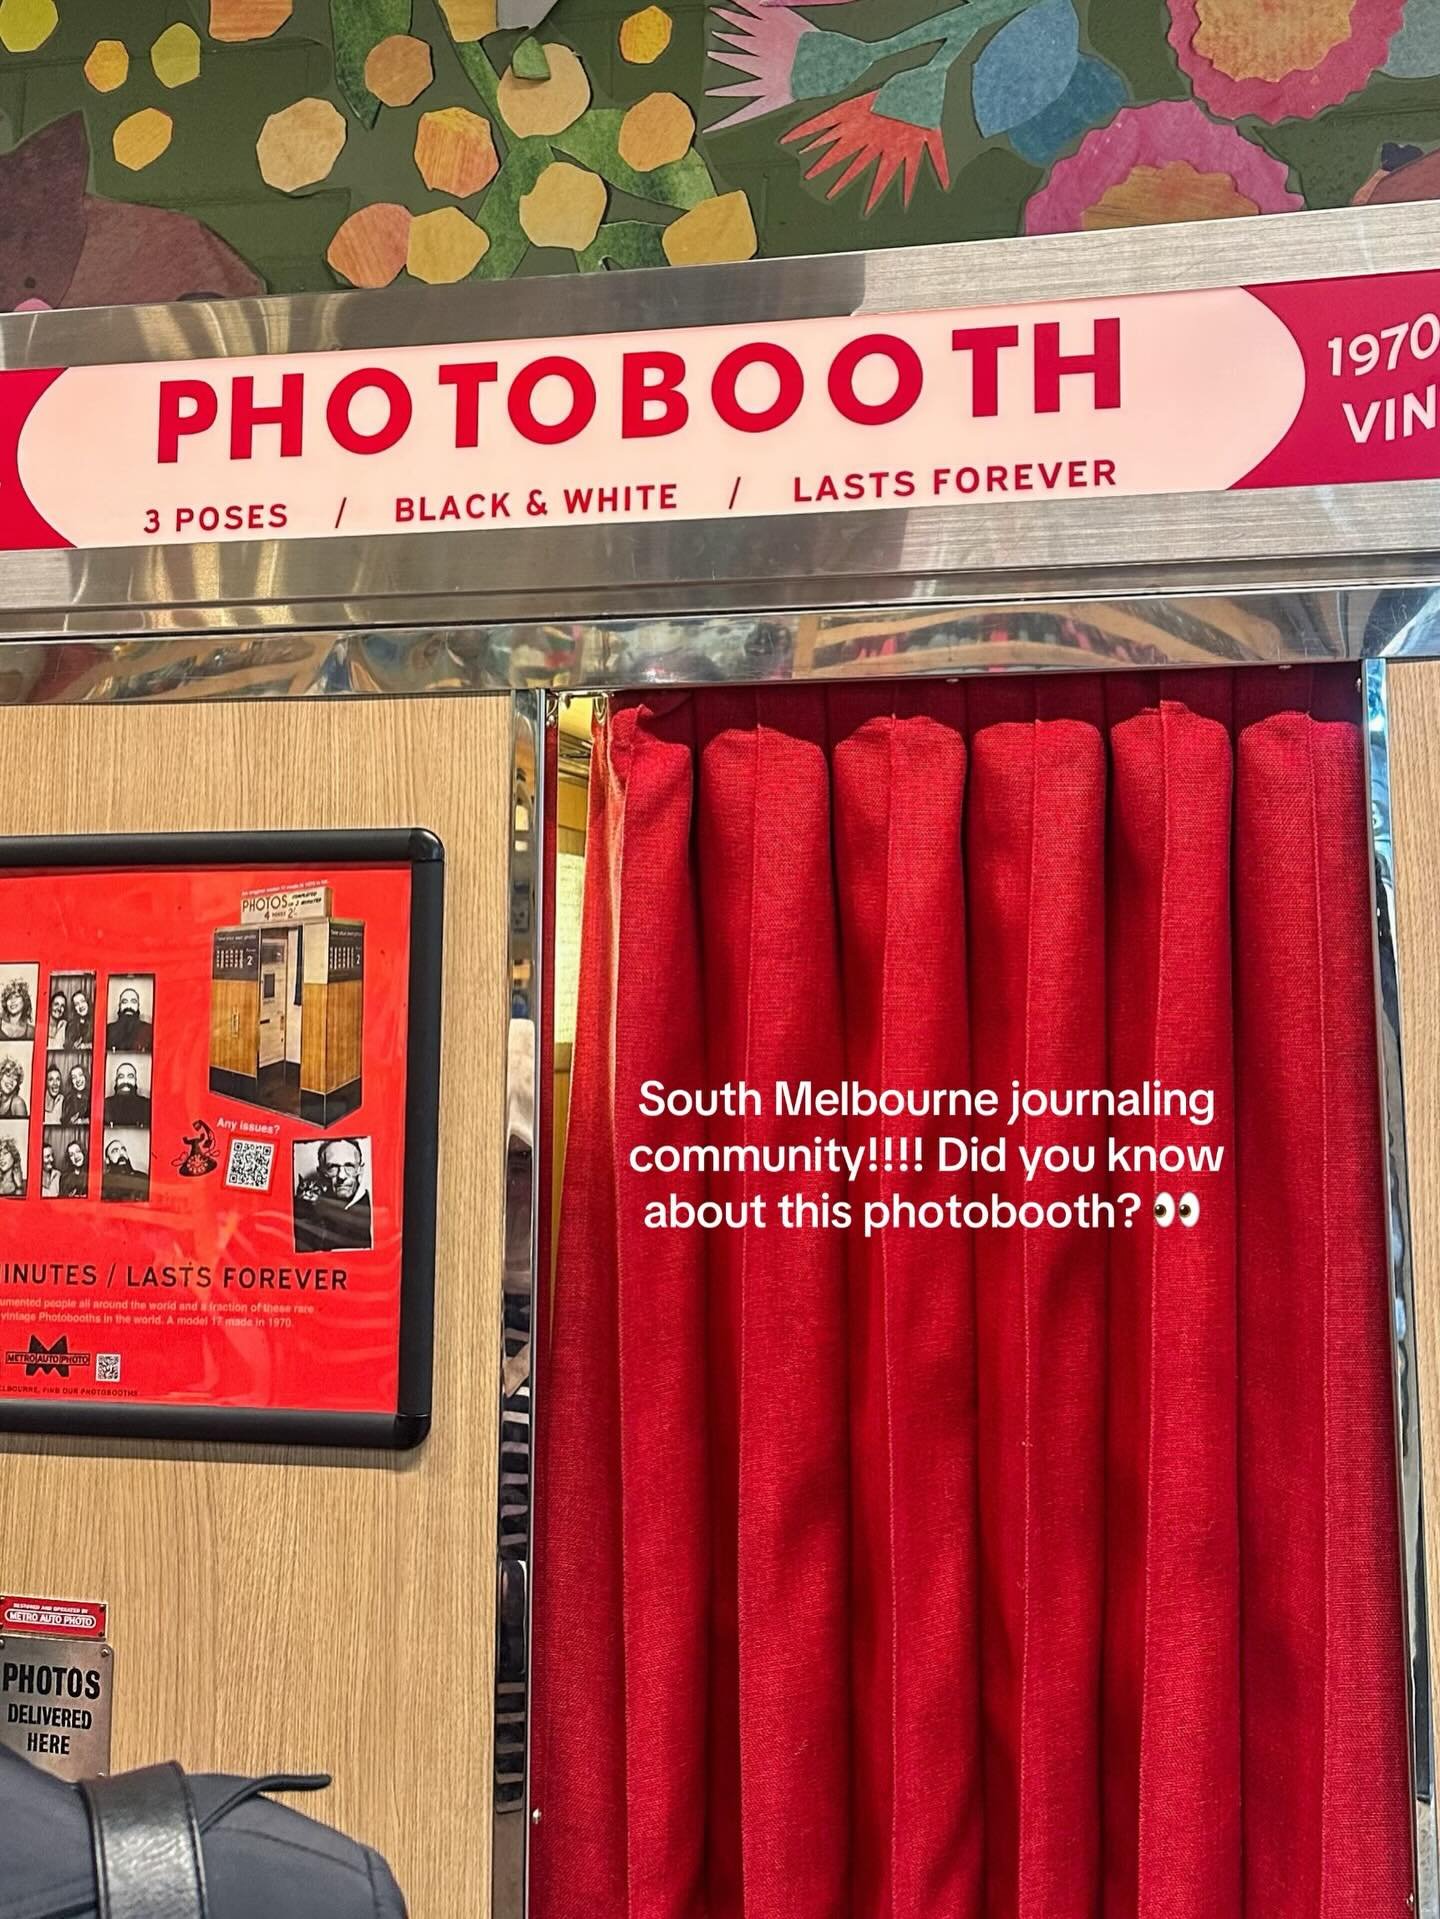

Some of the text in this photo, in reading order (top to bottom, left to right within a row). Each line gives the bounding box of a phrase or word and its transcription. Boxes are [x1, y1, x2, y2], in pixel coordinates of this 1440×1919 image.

[1328, 312, 1440, 376] 1970
[157, 317, 1121, 465] PHOTOBOOTH
[1341, 383, 1437, 444] VIN
[143, 459, 1117, 533] 3 POSES / BLACK & WHITE / LASTS FOREVER
[242, 894, 288, 912] PHOTOS
[216, 1117, 280, 1135] Any issues?
[0, 1263, 347, 1291] INUTES / LASTS FOREVER
[44, 1299, 76, 1310] people
[79, 1300, 90, 1309] all
[93, 1300, 128, 1309] around
[130, 1300, 146, 1309] the
[149, 1301, 177, 1311] world
[179, 1302, 198, 1311] and
[209, 1302, 248, 1312] fraction
[250, 1303, 262, 1312] of
[263, 1303, 291, 1313] these
[1, 1311, 35, 1322] vintage
[38, 1312, 101, 1323] Photobooths
[103, 1313, 112, 1322] in
[115, 1313, 130, 1323] the
[166, 1316, 174, 1325] A
[177, 1316, 208, 1326] model
[225, 1317, 253, 1327] made
[255, 1318, 265, 1327] in
[7, 1353, 88, 1364] METRO AUTO PHOTO
[9, 1611, 93, 1626] METRO AUTO PHOTO
[2, 1662, 101, 1700] PHOTOS
[7, 1703, 93, 1730] DELIVERED
[27, 1732, 71, 1755] HERE
